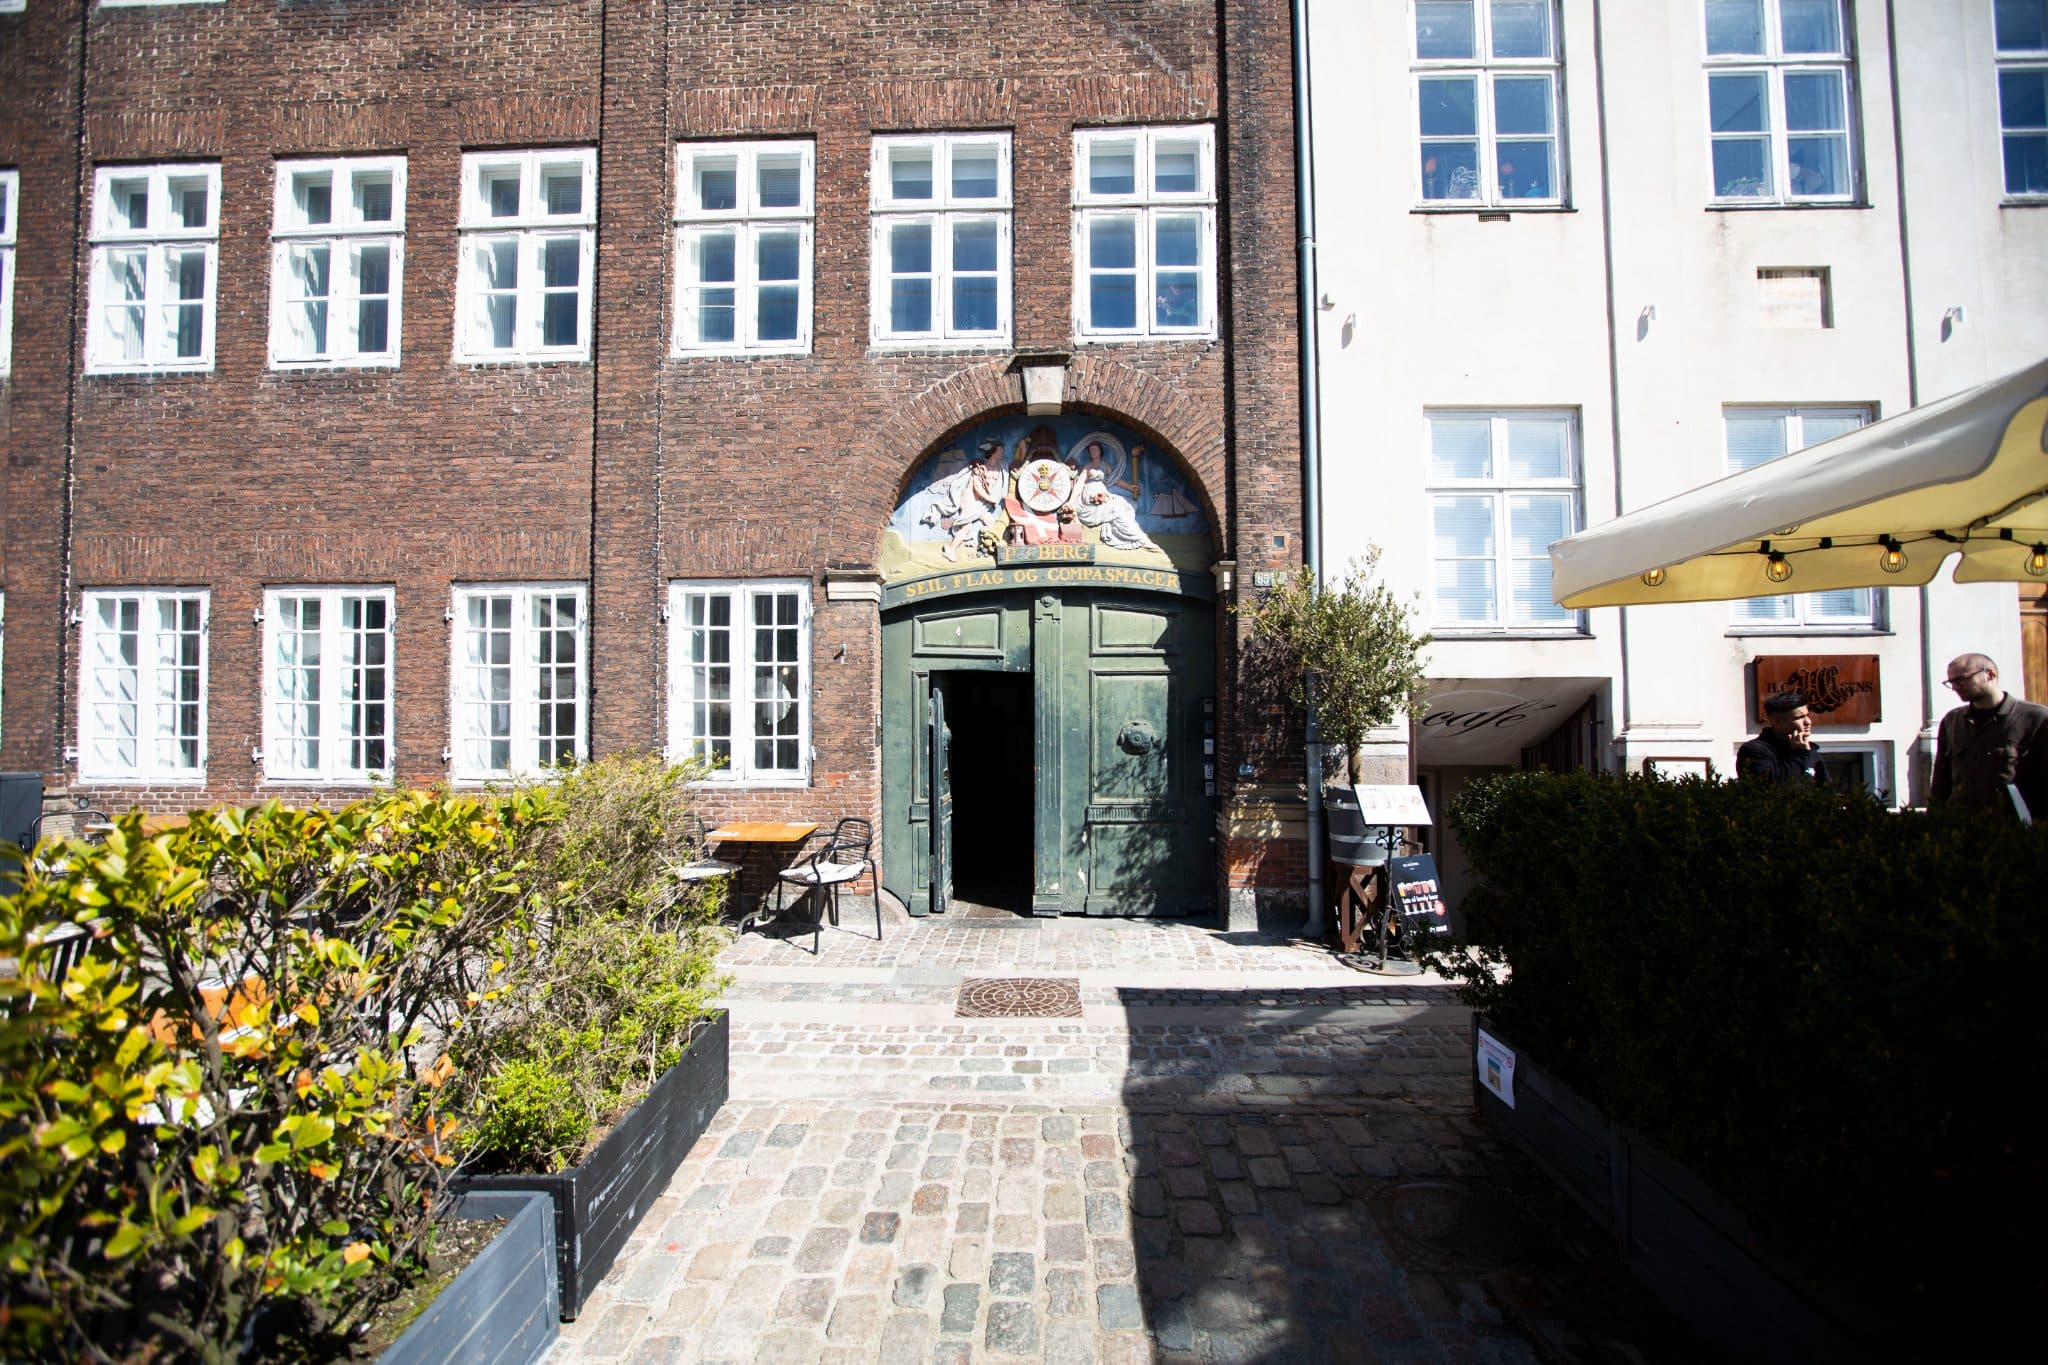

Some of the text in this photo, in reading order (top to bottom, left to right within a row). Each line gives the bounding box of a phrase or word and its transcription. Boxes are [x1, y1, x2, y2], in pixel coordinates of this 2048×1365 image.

[1037, 544, 1090, 560] BERG
[906, 567, 1179, 598] SEIL FLAG OG COMPASMAGER
